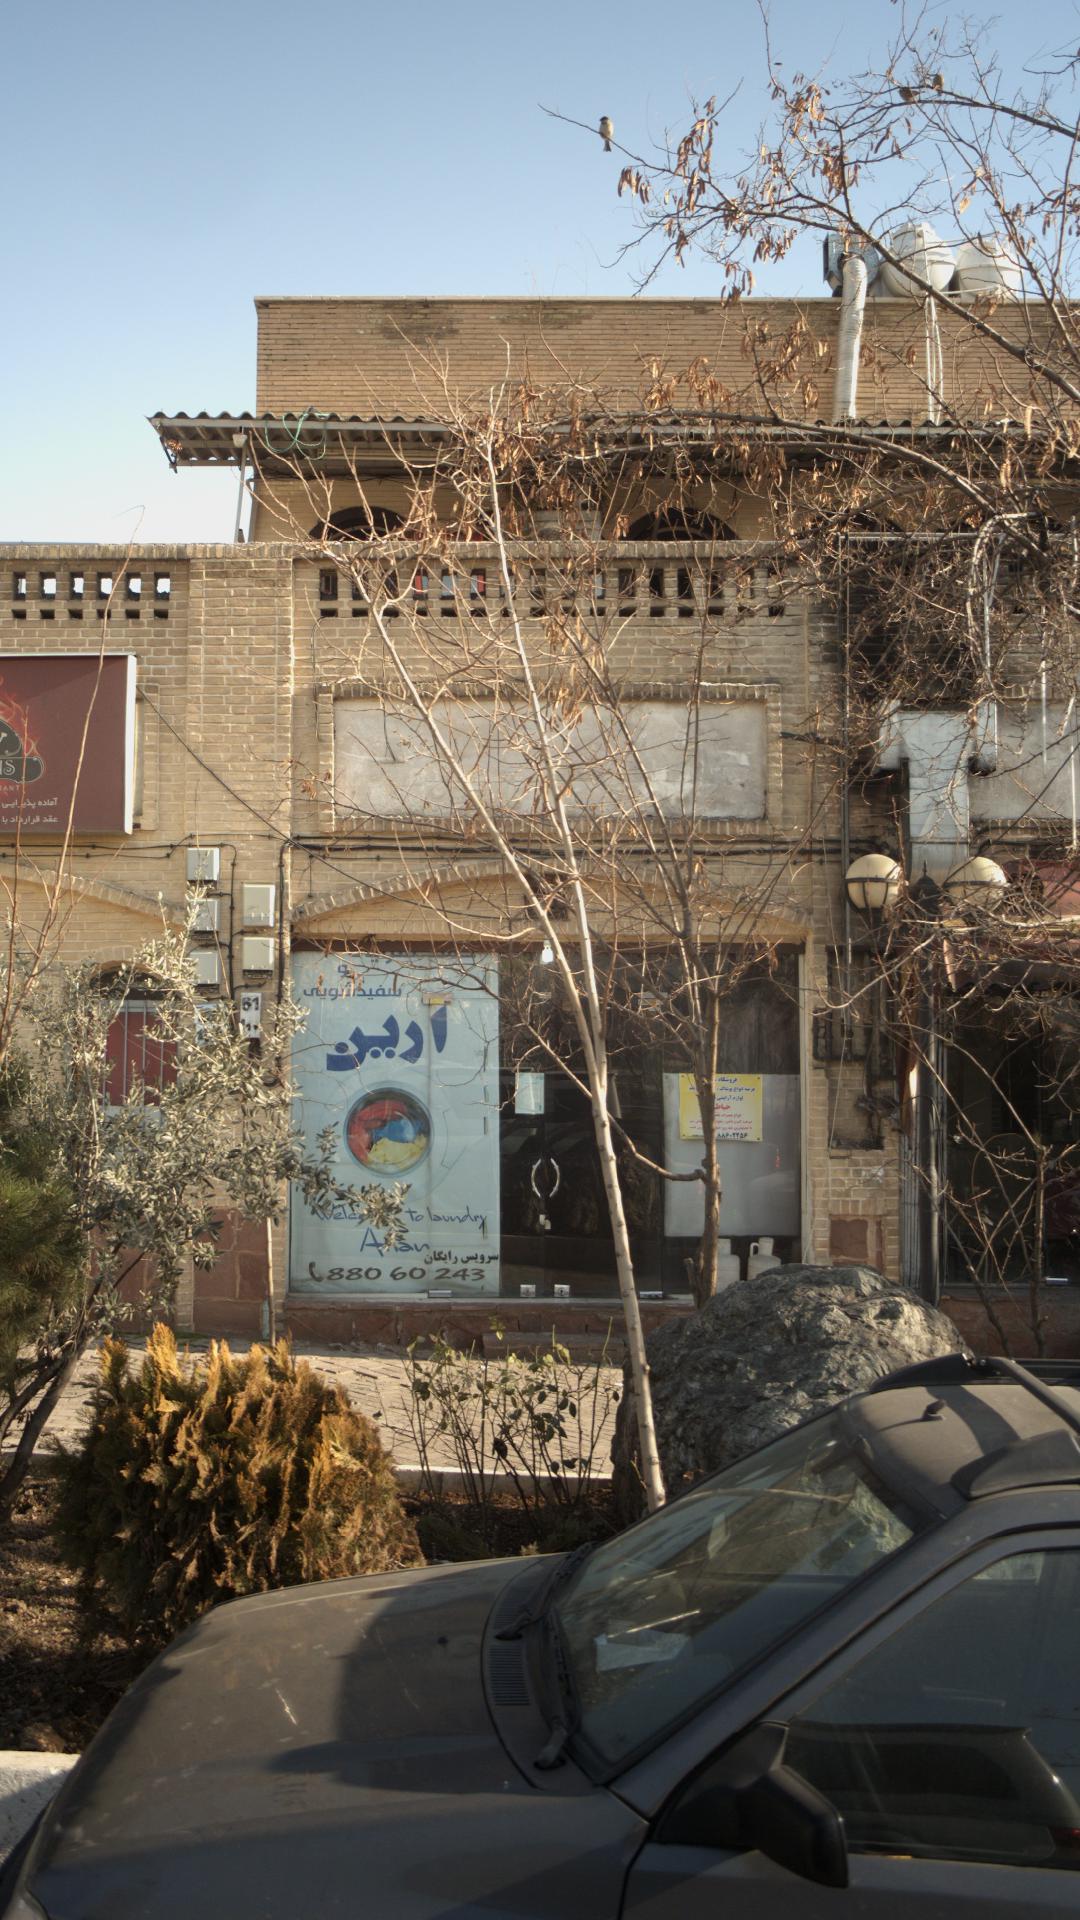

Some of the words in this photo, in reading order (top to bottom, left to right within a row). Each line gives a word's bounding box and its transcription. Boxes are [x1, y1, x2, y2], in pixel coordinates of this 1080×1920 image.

[37, 797, 58, 806] آماده
[424, 1249, 459, 1265] رایگان
[460, 1251, 499, 1264] سرویس
[326, 1267, 382, 1281] 880
[389, 1266, 426, 1281] 60
[433, 1267, 486, 1281] 243
